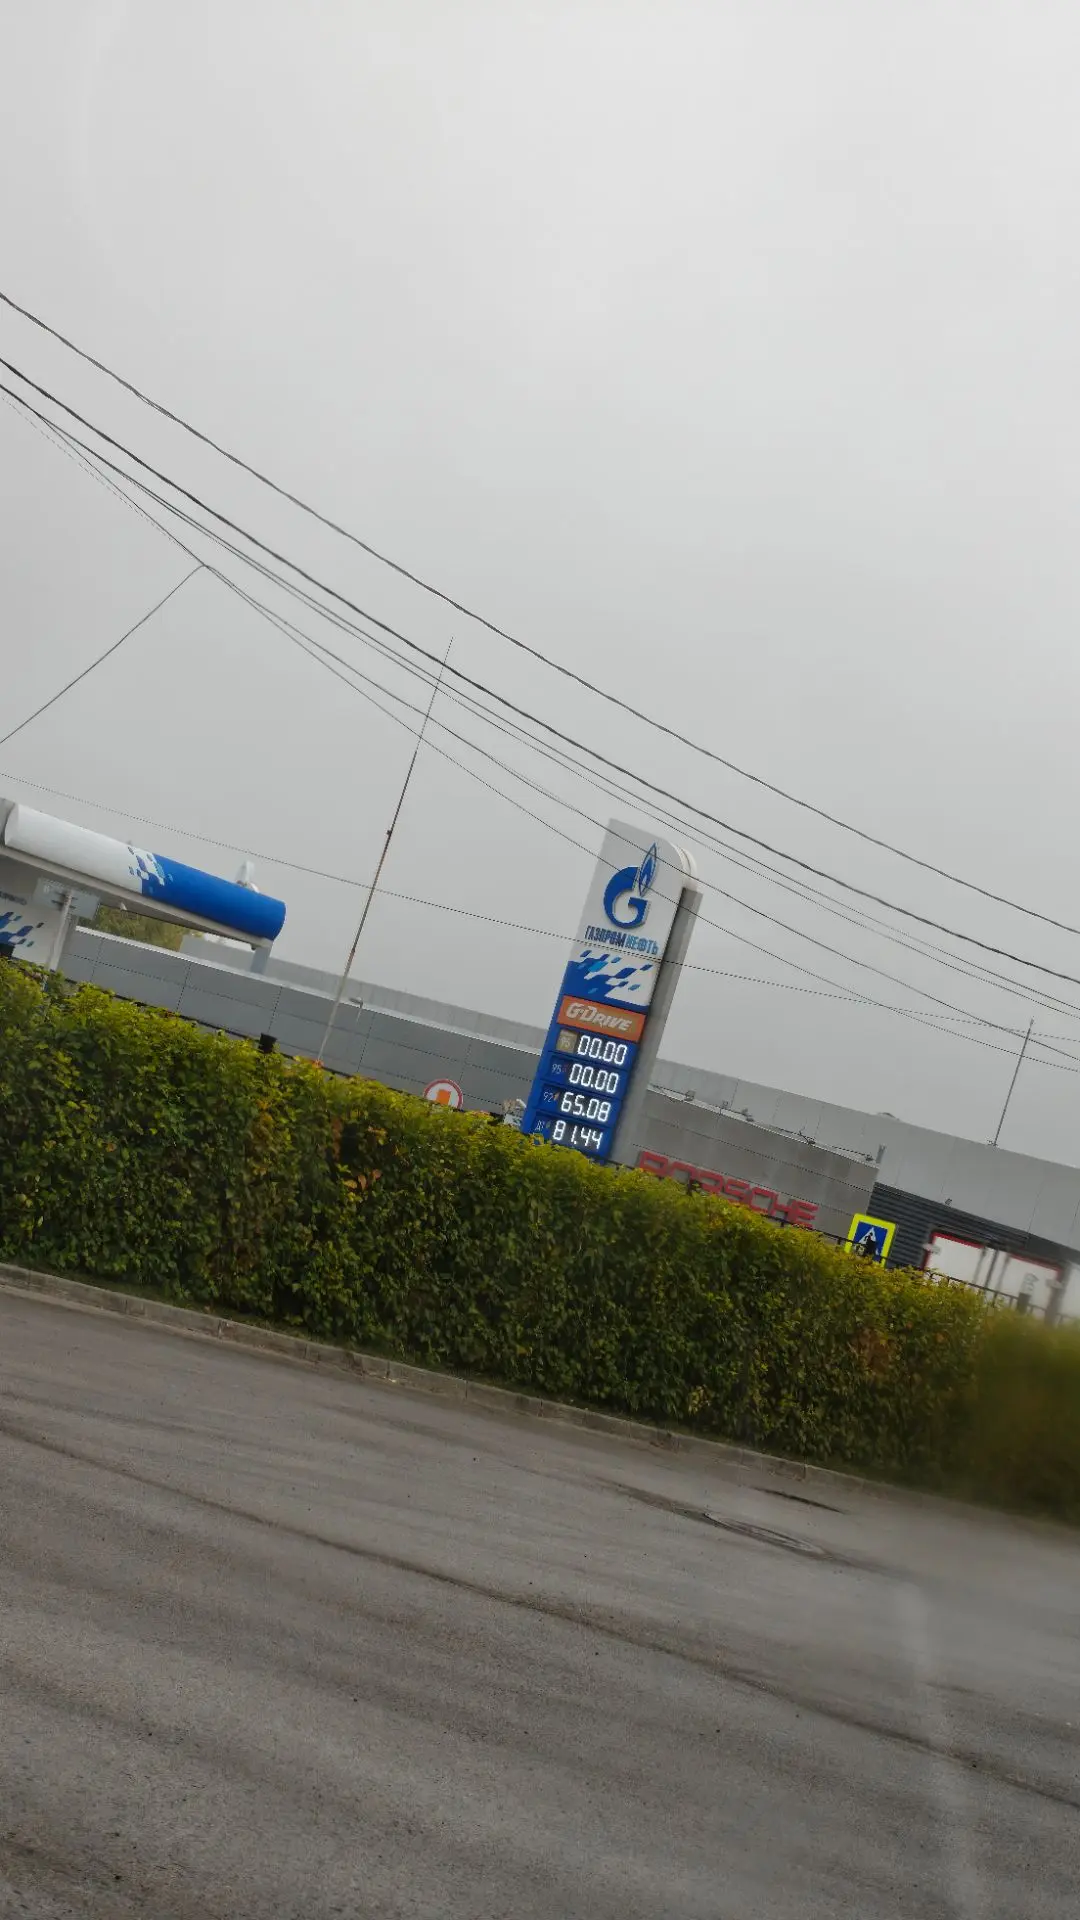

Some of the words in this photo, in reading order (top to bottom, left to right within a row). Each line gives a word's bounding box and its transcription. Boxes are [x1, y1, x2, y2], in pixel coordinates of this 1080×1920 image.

[577, 1034, 628, 1065] 00.00
[551, 1063, 562, 1075] 95
[569, 1063, 619, 1094] 00.00
[543, 1091, 554, 1103] 92
[561, 1091, 612, 1123] 65.08
[552, 1119, 603, 1150] 81.44
